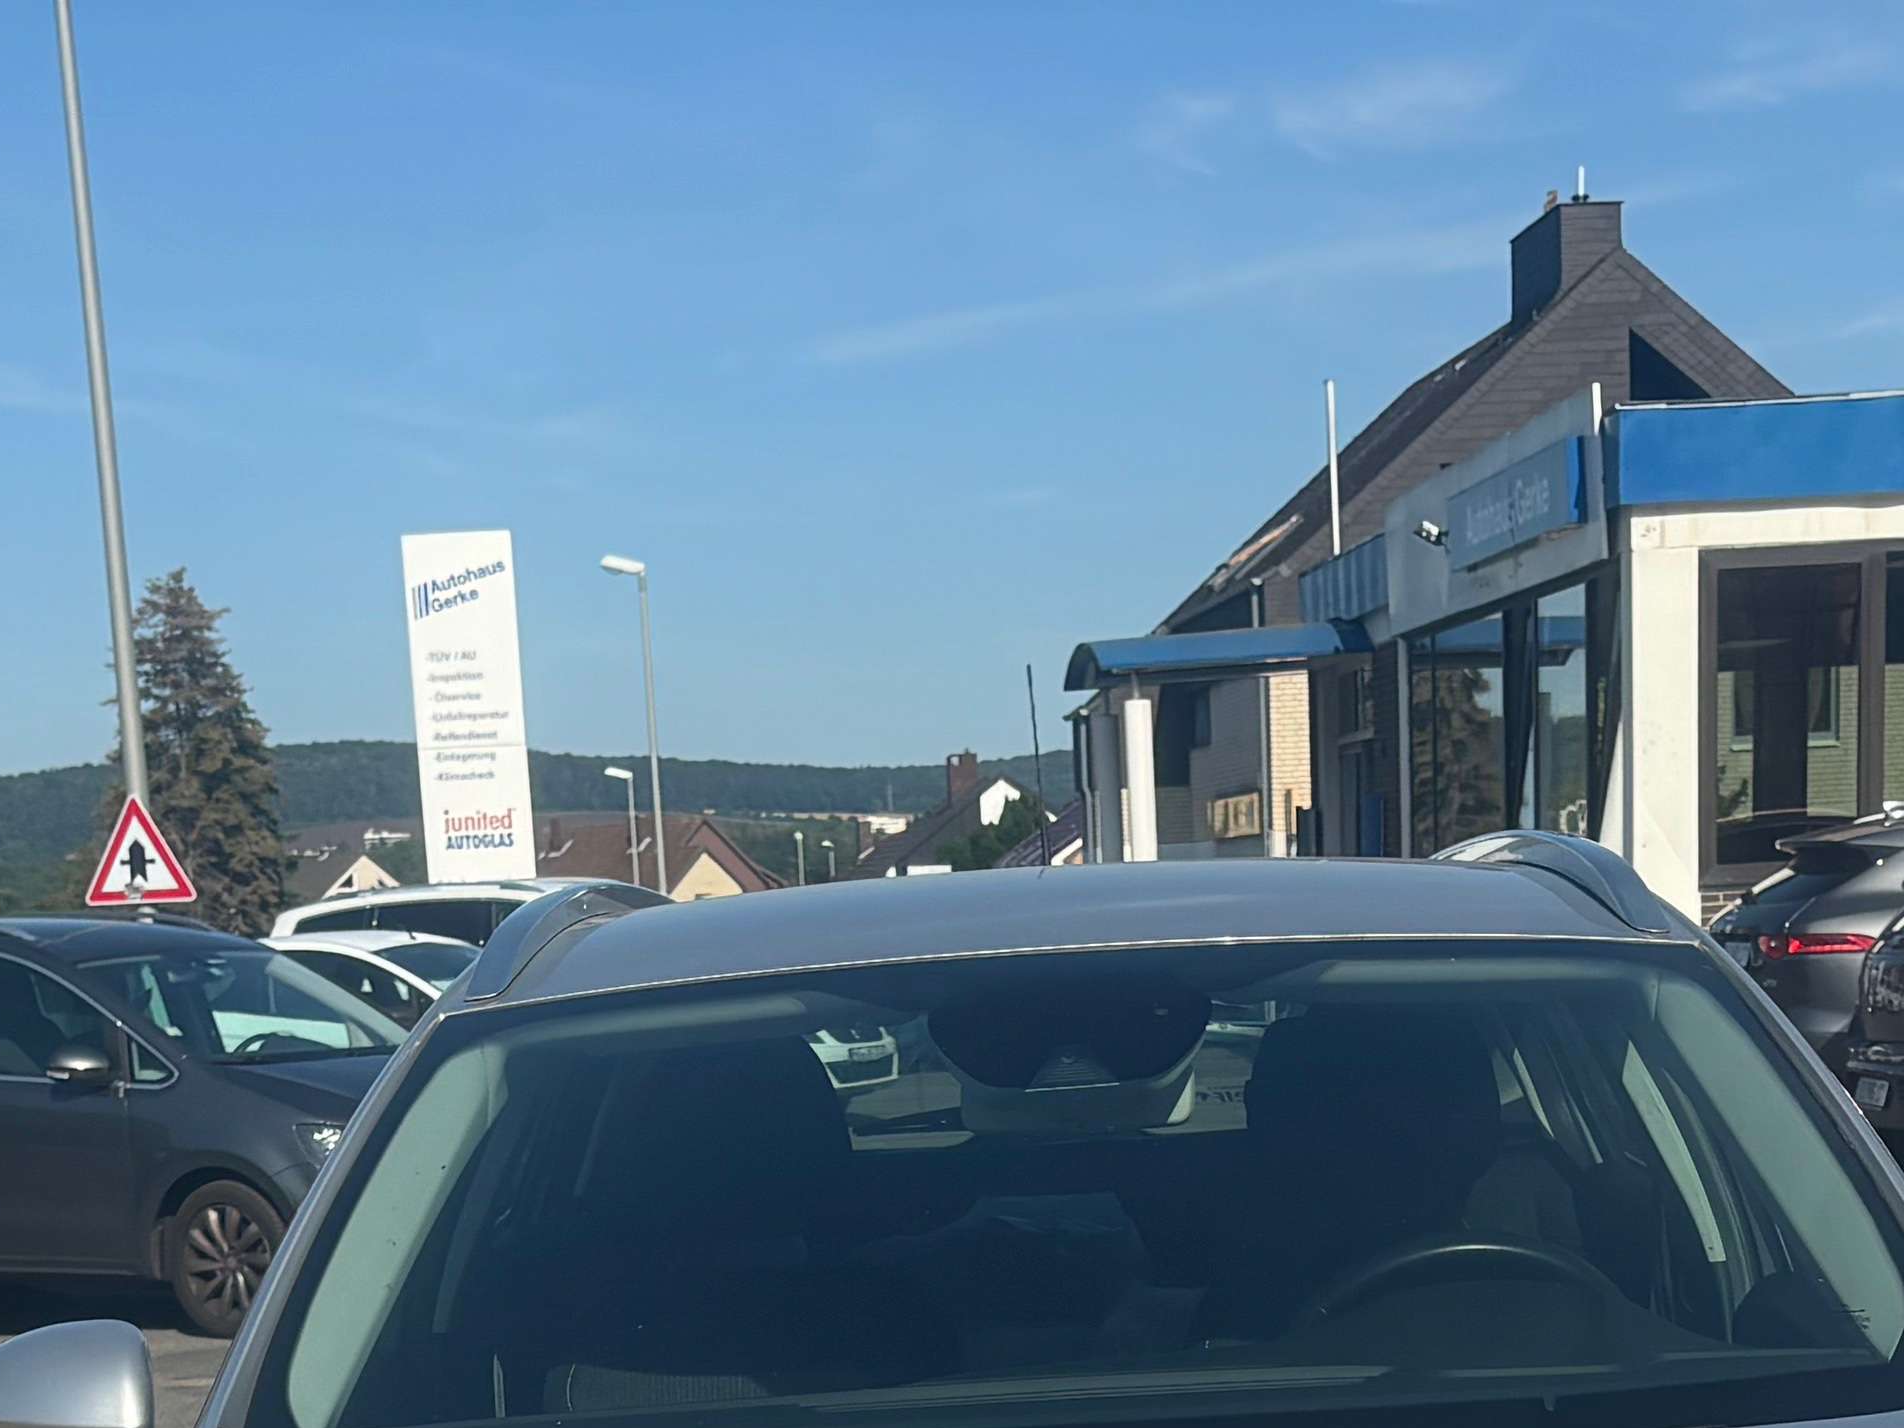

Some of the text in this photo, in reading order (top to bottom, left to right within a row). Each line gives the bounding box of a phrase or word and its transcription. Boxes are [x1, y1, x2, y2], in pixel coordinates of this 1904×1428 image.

[431, 561, 506, 594] Autohaus
[432, 589, 479, 612] Gerke
[443, 807, 513, 834] junited
[446, 832, 515, 851] AUTOGLAS
